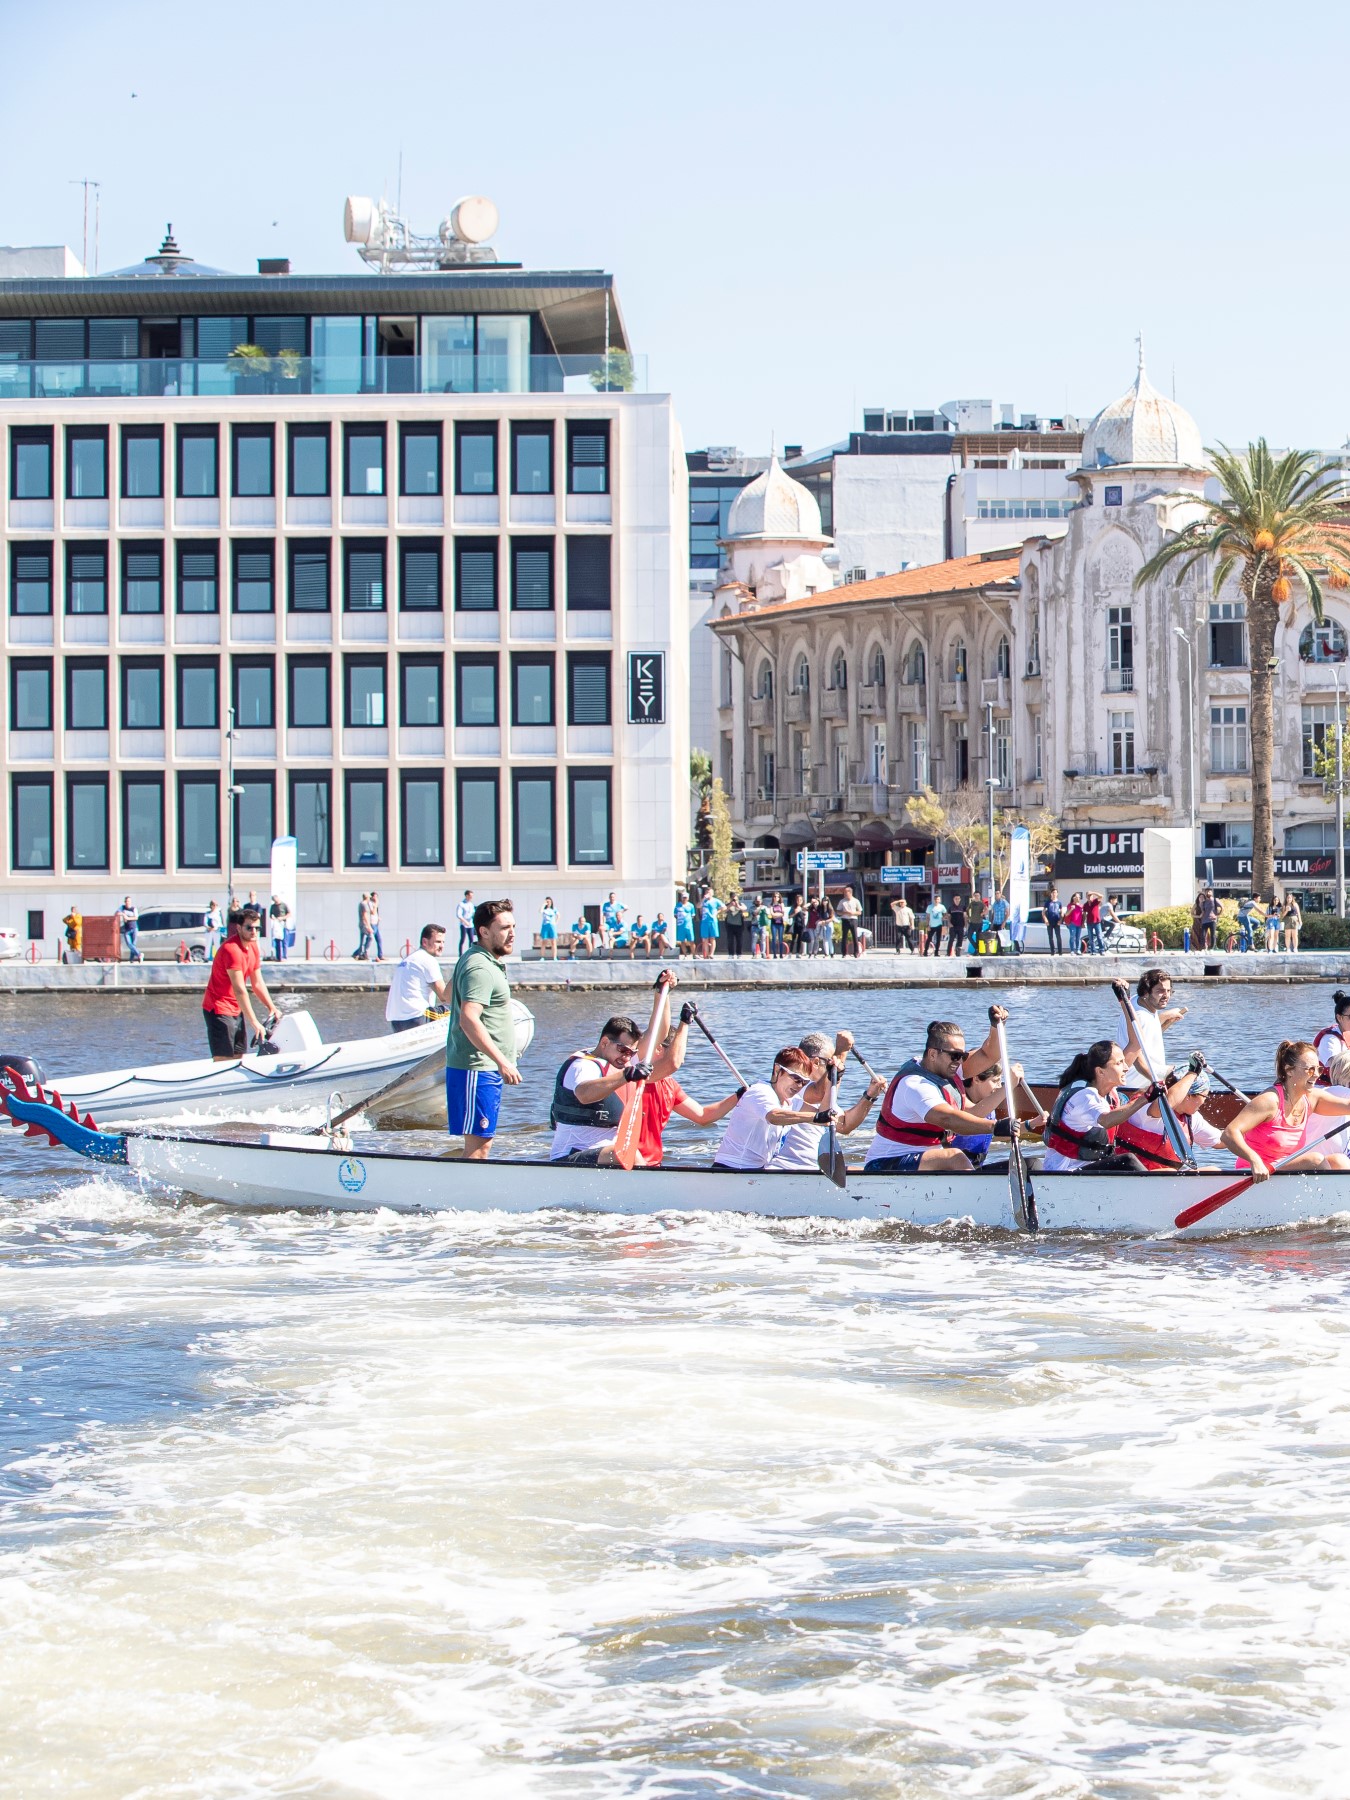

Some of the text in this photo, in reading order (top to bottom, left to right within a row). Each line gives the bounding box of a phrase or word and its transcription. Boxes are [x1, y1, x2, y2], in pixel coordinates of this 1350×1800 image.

[637, 659, 655, 716] KEY
[1068, 833, 1144, 855] FUJIFI
[939, 866, 959, 877] ECZANE
[1084, 864, 1144, 873] İZMİR SHOWROO
[1309, 858, 1332, 875] Shop
